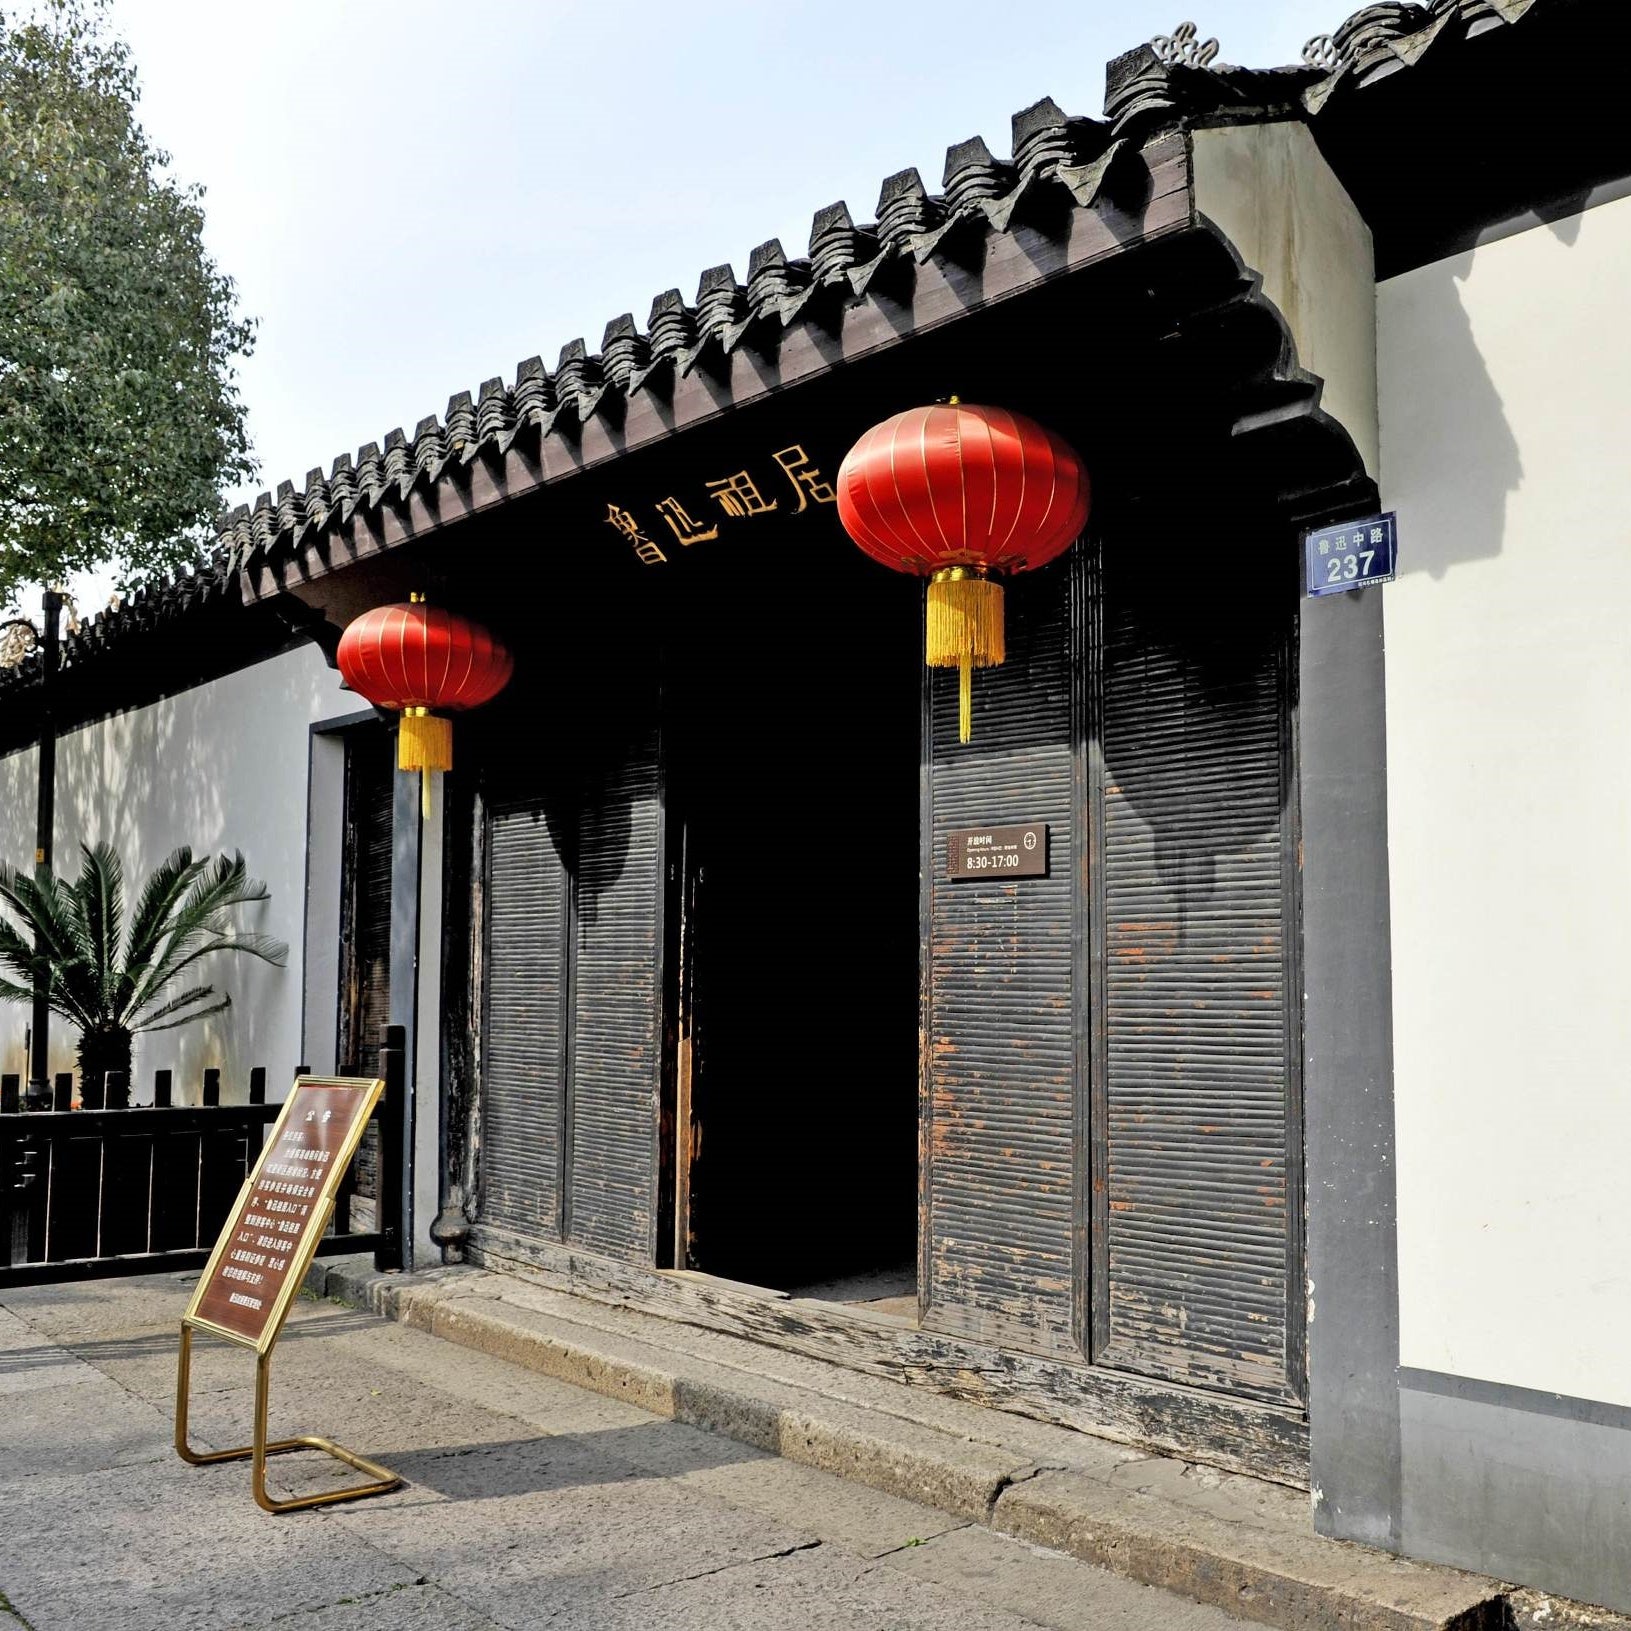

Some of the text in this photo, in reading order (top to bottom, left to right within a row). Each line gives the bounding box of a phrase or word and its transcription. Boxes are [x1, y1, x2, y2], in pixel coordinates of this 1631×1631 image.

[1318, 527, 1384, 555] 鲁迅中路
[1327, 550, 1375, 583] 237
[967, 854, 1019, 870] 8:30-17:00
